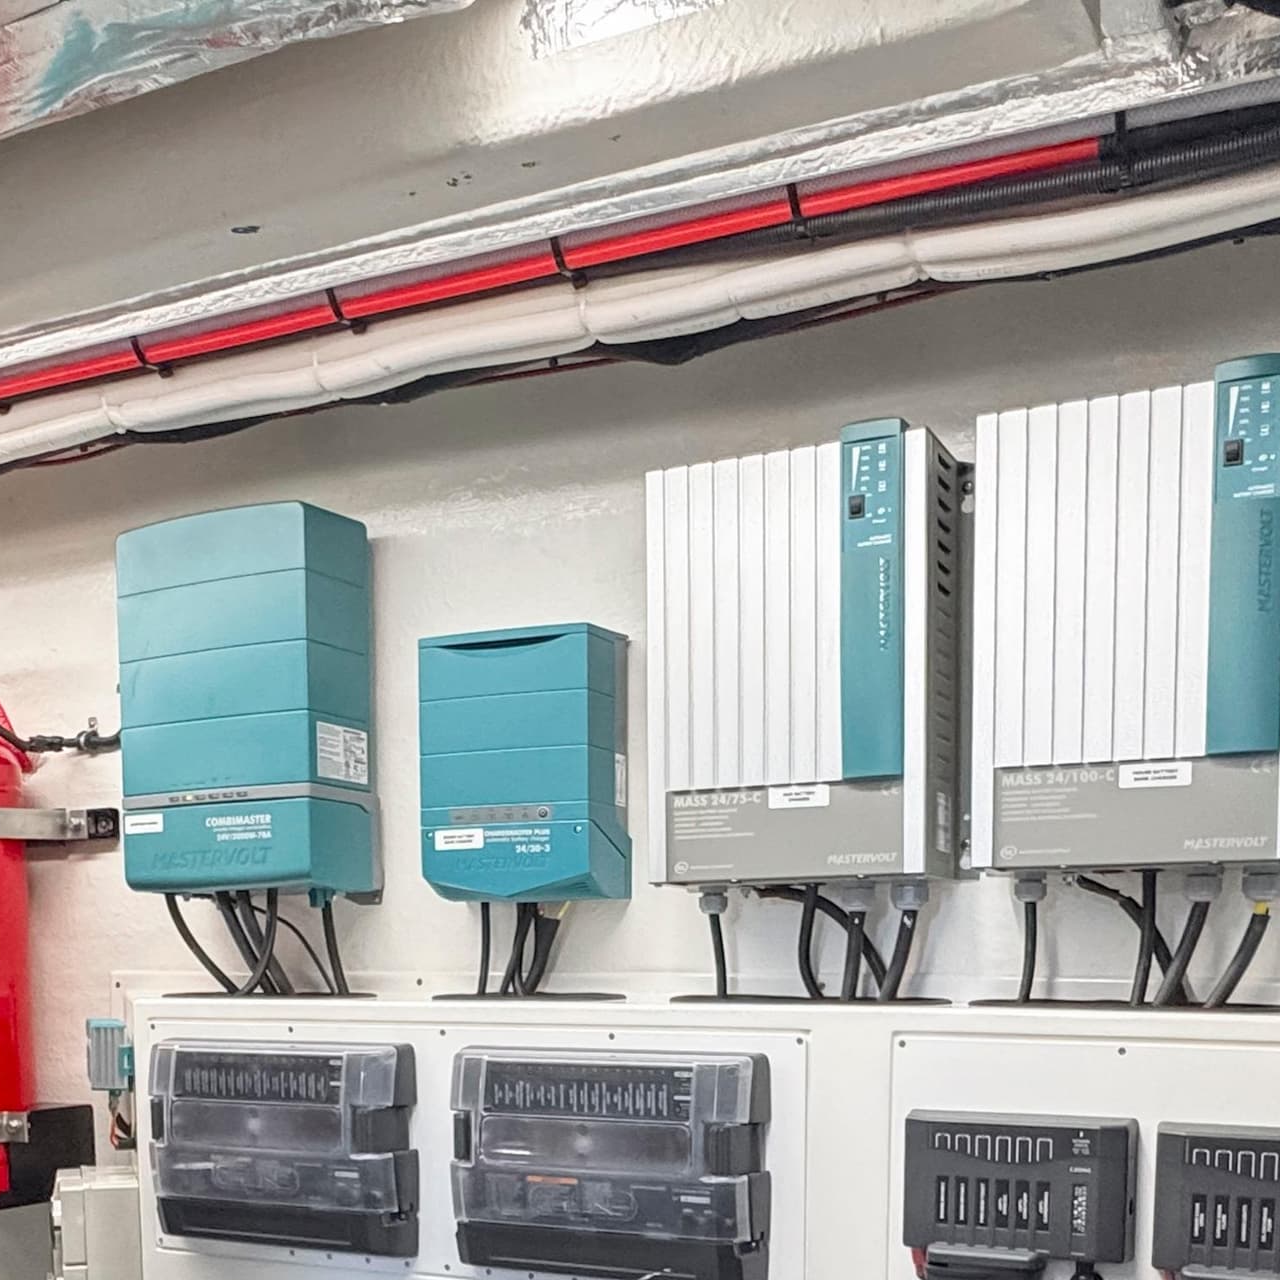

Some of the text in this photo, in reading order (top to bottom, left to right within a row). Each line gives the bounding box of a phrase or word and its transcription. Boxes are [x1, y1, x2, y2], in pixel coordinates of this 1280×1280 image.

[1002, 769, 1114, 787] MASS 24/100-C
[673, 792, 761, 808] MASS 24/75-C
[206, 813, 272, 828] COMBIMASTER
[1184, 836, 1268, 850] MASTERVOLT
[827, 852, 898, 866] MASTERVOLT
